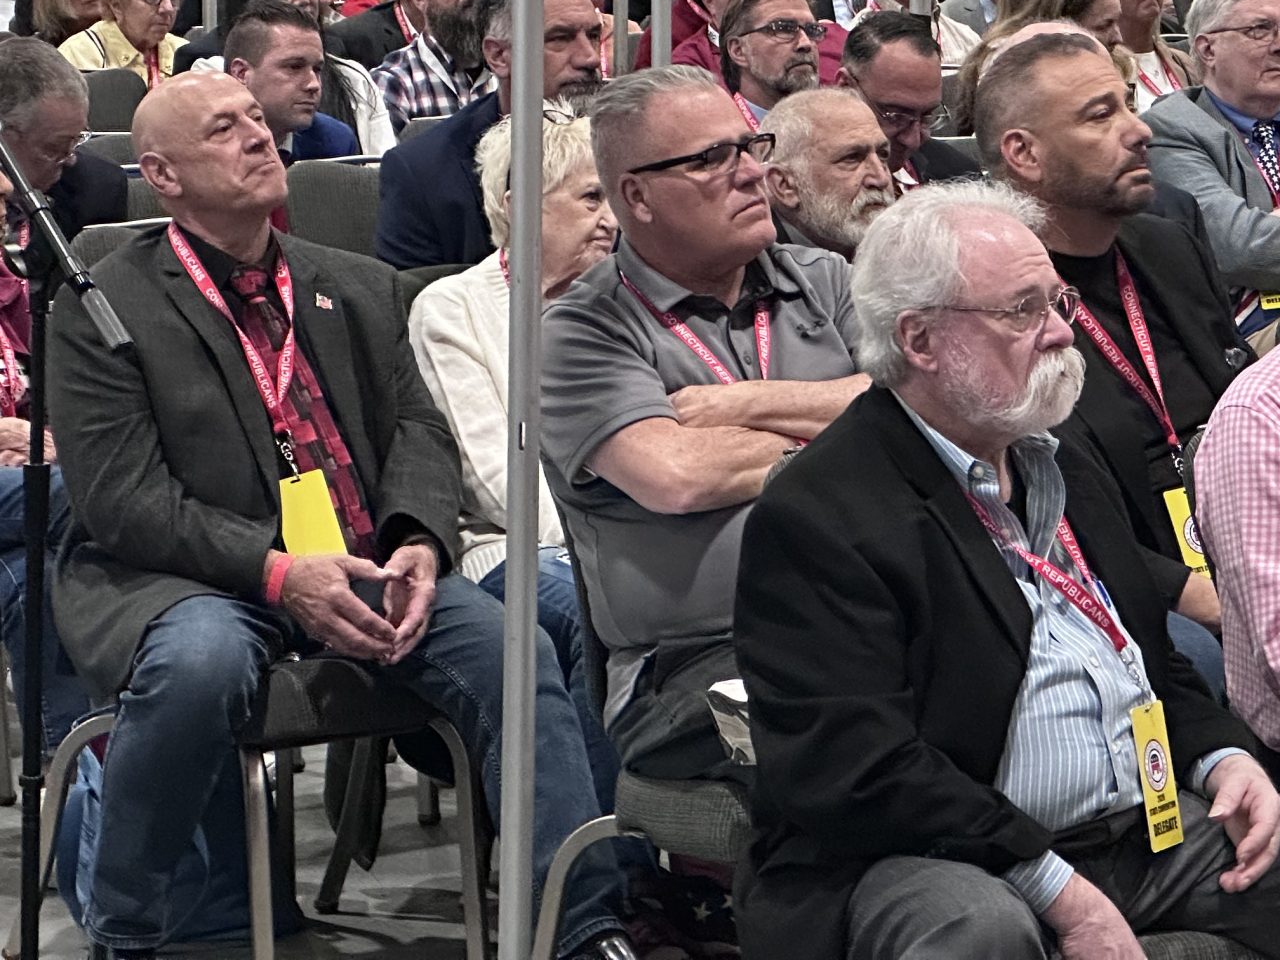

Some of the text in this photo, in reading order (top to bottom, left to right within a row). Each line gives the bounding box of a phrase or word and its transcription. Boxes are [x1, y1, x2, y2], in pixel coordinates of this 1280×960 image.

[662, 312, 717, 366] CONNECTICUT
[1123, 286, 1151, 353] CONNECTICUT
[1041, 565, 1110, 628] REPUBLICANS
